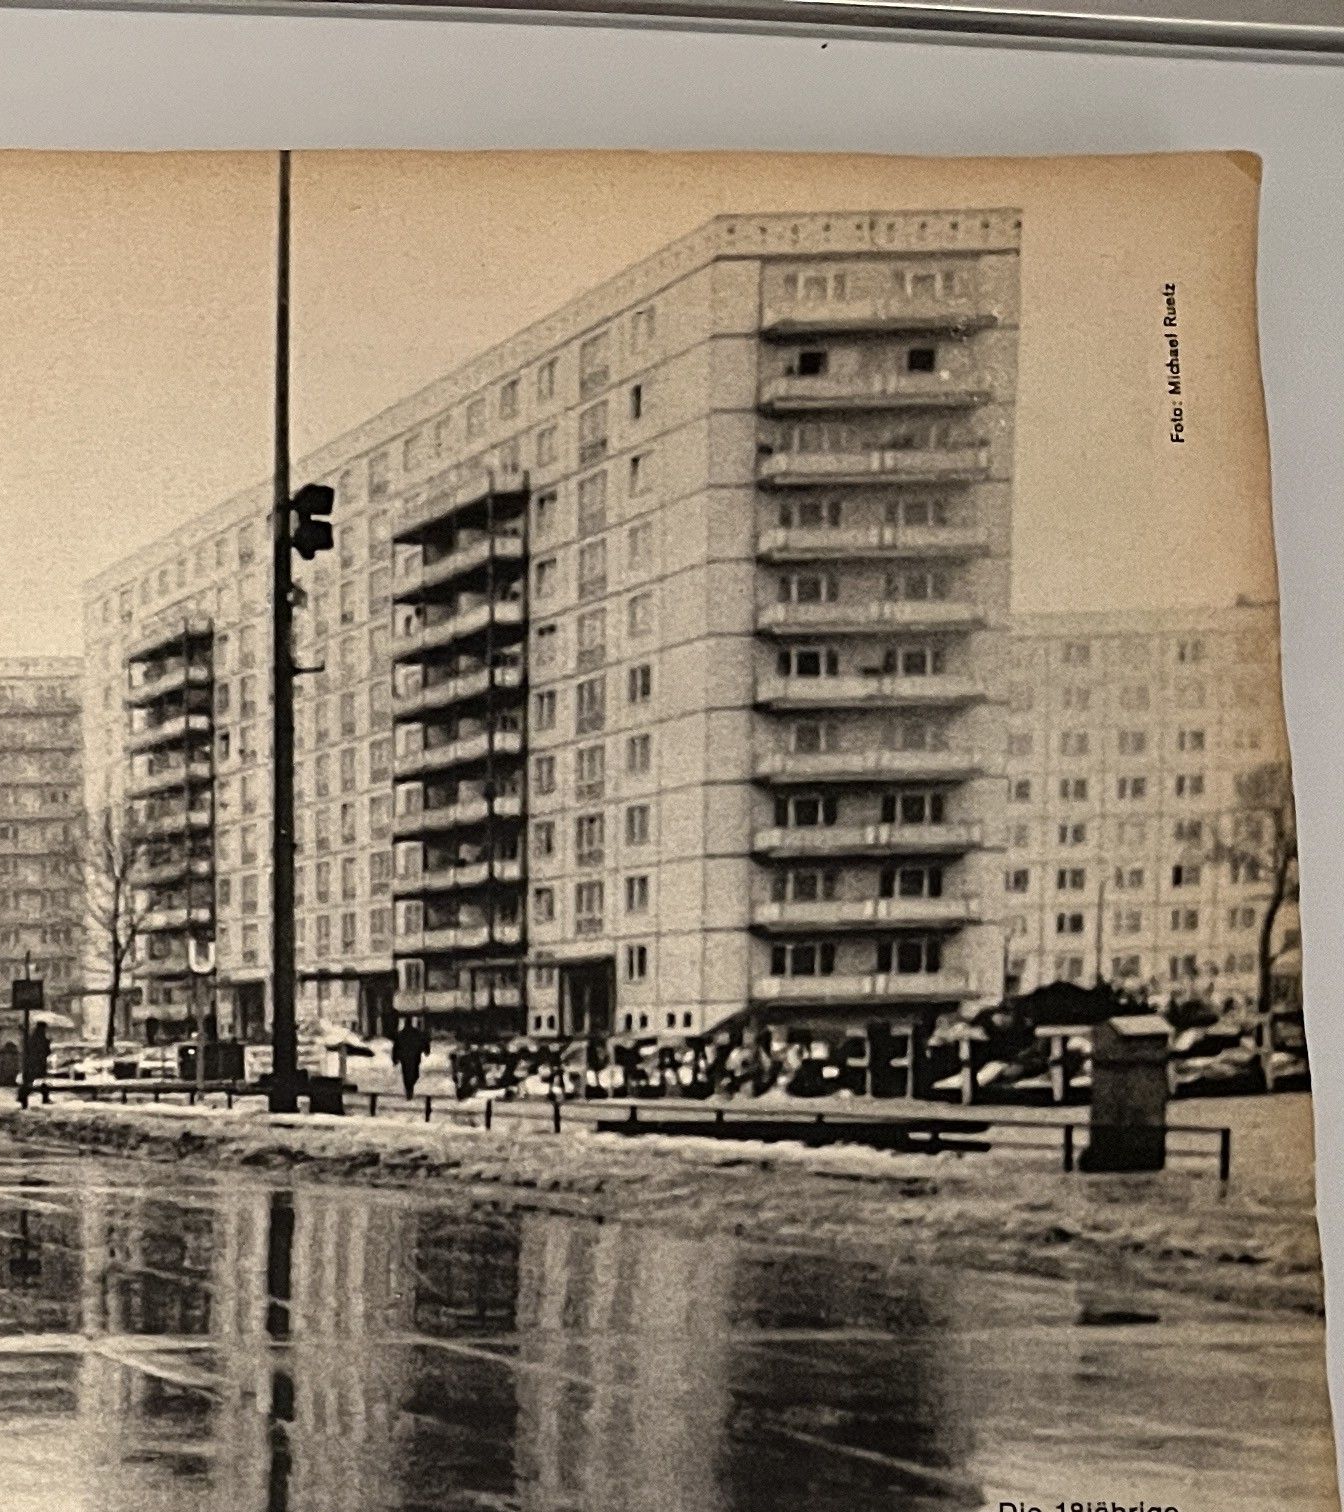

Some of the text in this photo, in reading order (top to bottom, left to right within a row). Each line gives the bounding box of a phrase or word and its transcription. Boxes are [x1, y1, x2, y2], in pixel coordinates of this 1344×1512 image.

[1162, 282, 1185, 443] Foto: Michael Ruetz
